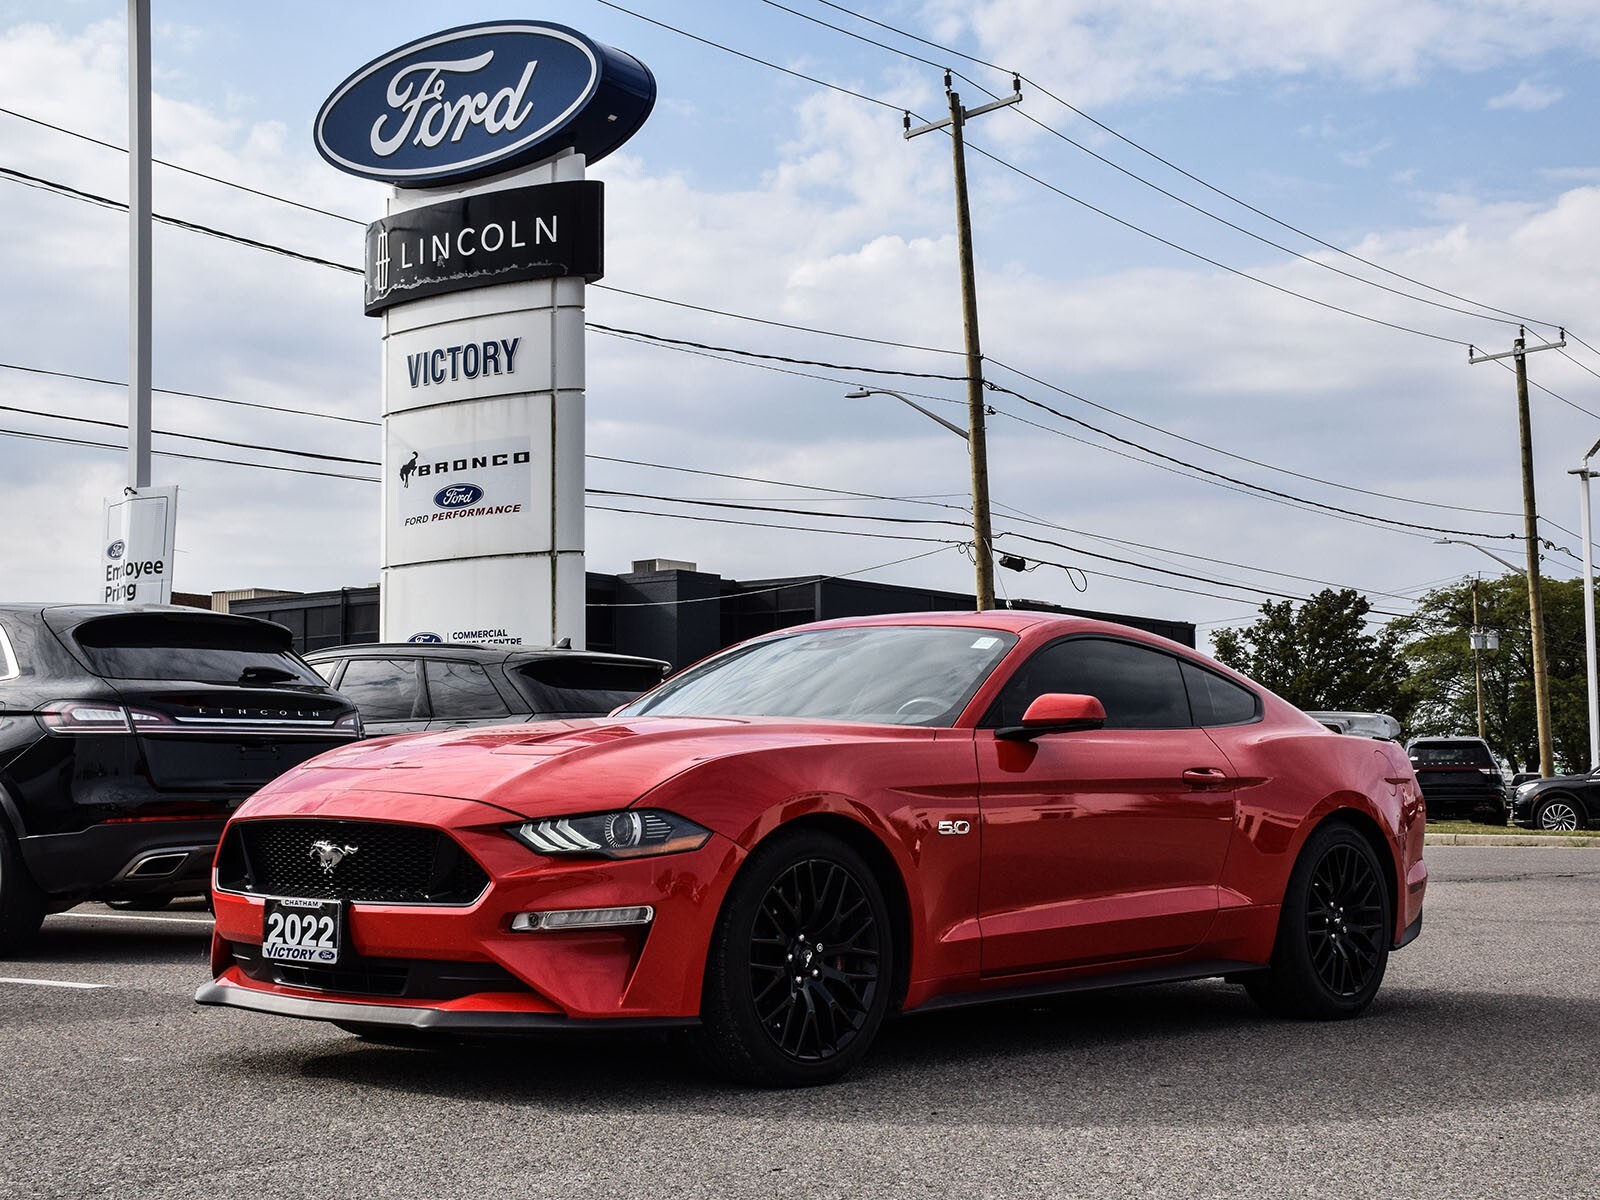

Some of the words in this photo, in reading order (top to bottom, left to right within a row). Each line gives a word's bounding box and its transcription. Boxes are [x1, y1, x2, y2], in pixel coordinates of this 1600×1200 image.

[370, 50, 538, 156] Ford
[401, 215, 557, 269] LINCOLN
[407, 337, 521, 387] VICTORY
[418, 451, 530, 476] BRONCO
[443, 487, 473, 505] Ford
[404, 514, 429, 526] FORD
[431, 504, 521, 522] PERFORMANCE
[106, 559, 164, 581] Emloyee
[452, 629, 508, 640] COMMERCIAL
[199, 708, 320, 717] LINCOLN
[284, 899, 319, 907] CHATHAM
[267, 912, 334, 948] 2022
[266, 943, 316, 960] VICTORY
